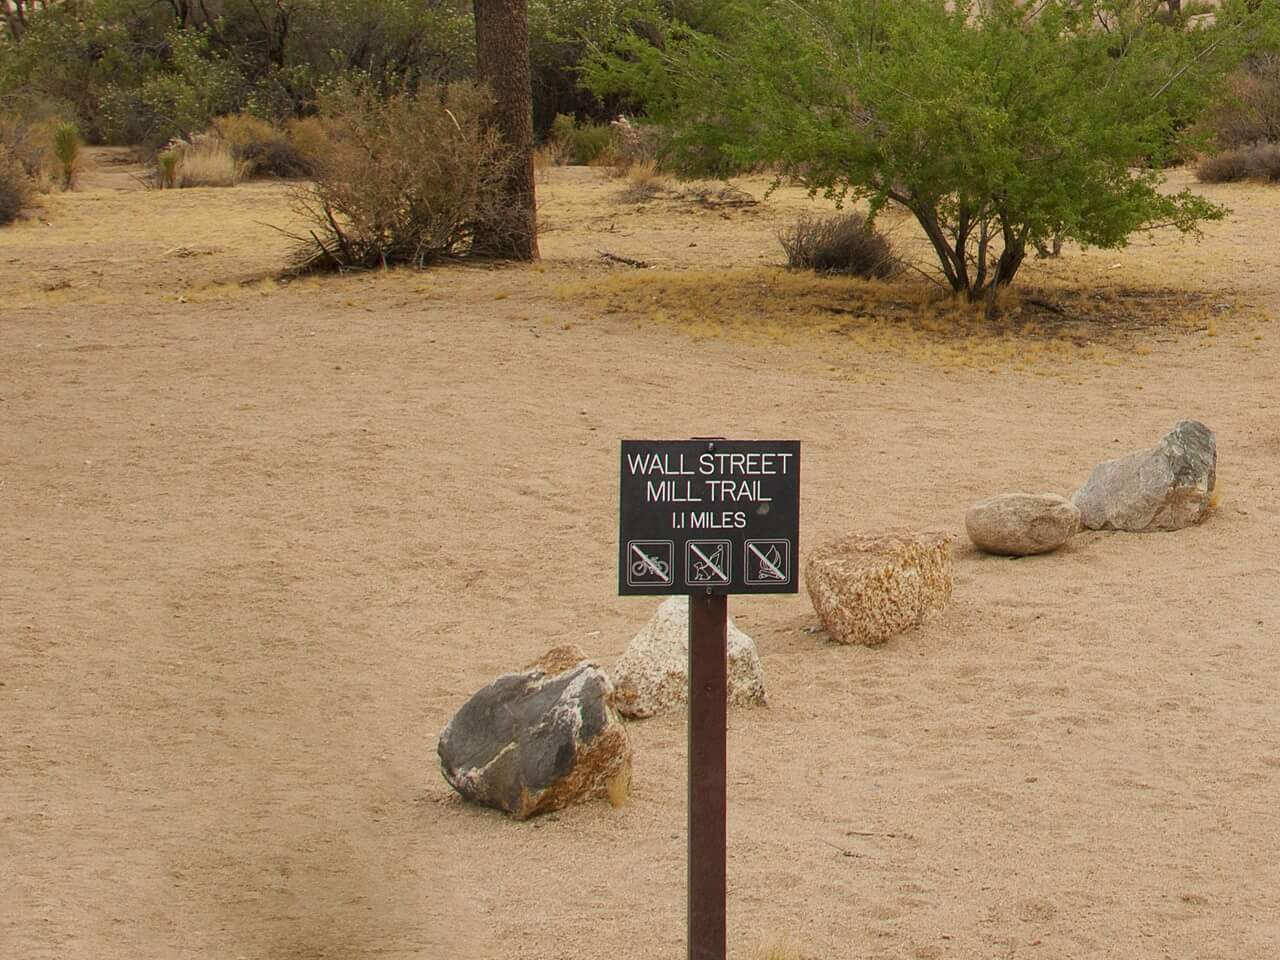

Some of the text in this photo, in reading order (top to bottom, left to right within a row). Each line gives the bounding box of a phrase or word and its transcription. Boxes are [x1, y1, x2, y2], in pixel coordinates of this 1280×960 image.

[627, 453, 793, 476] WALL STREET
[647, 480, 773, 502] MILL TRAIL
[690, 511, 747, 529] MILES
